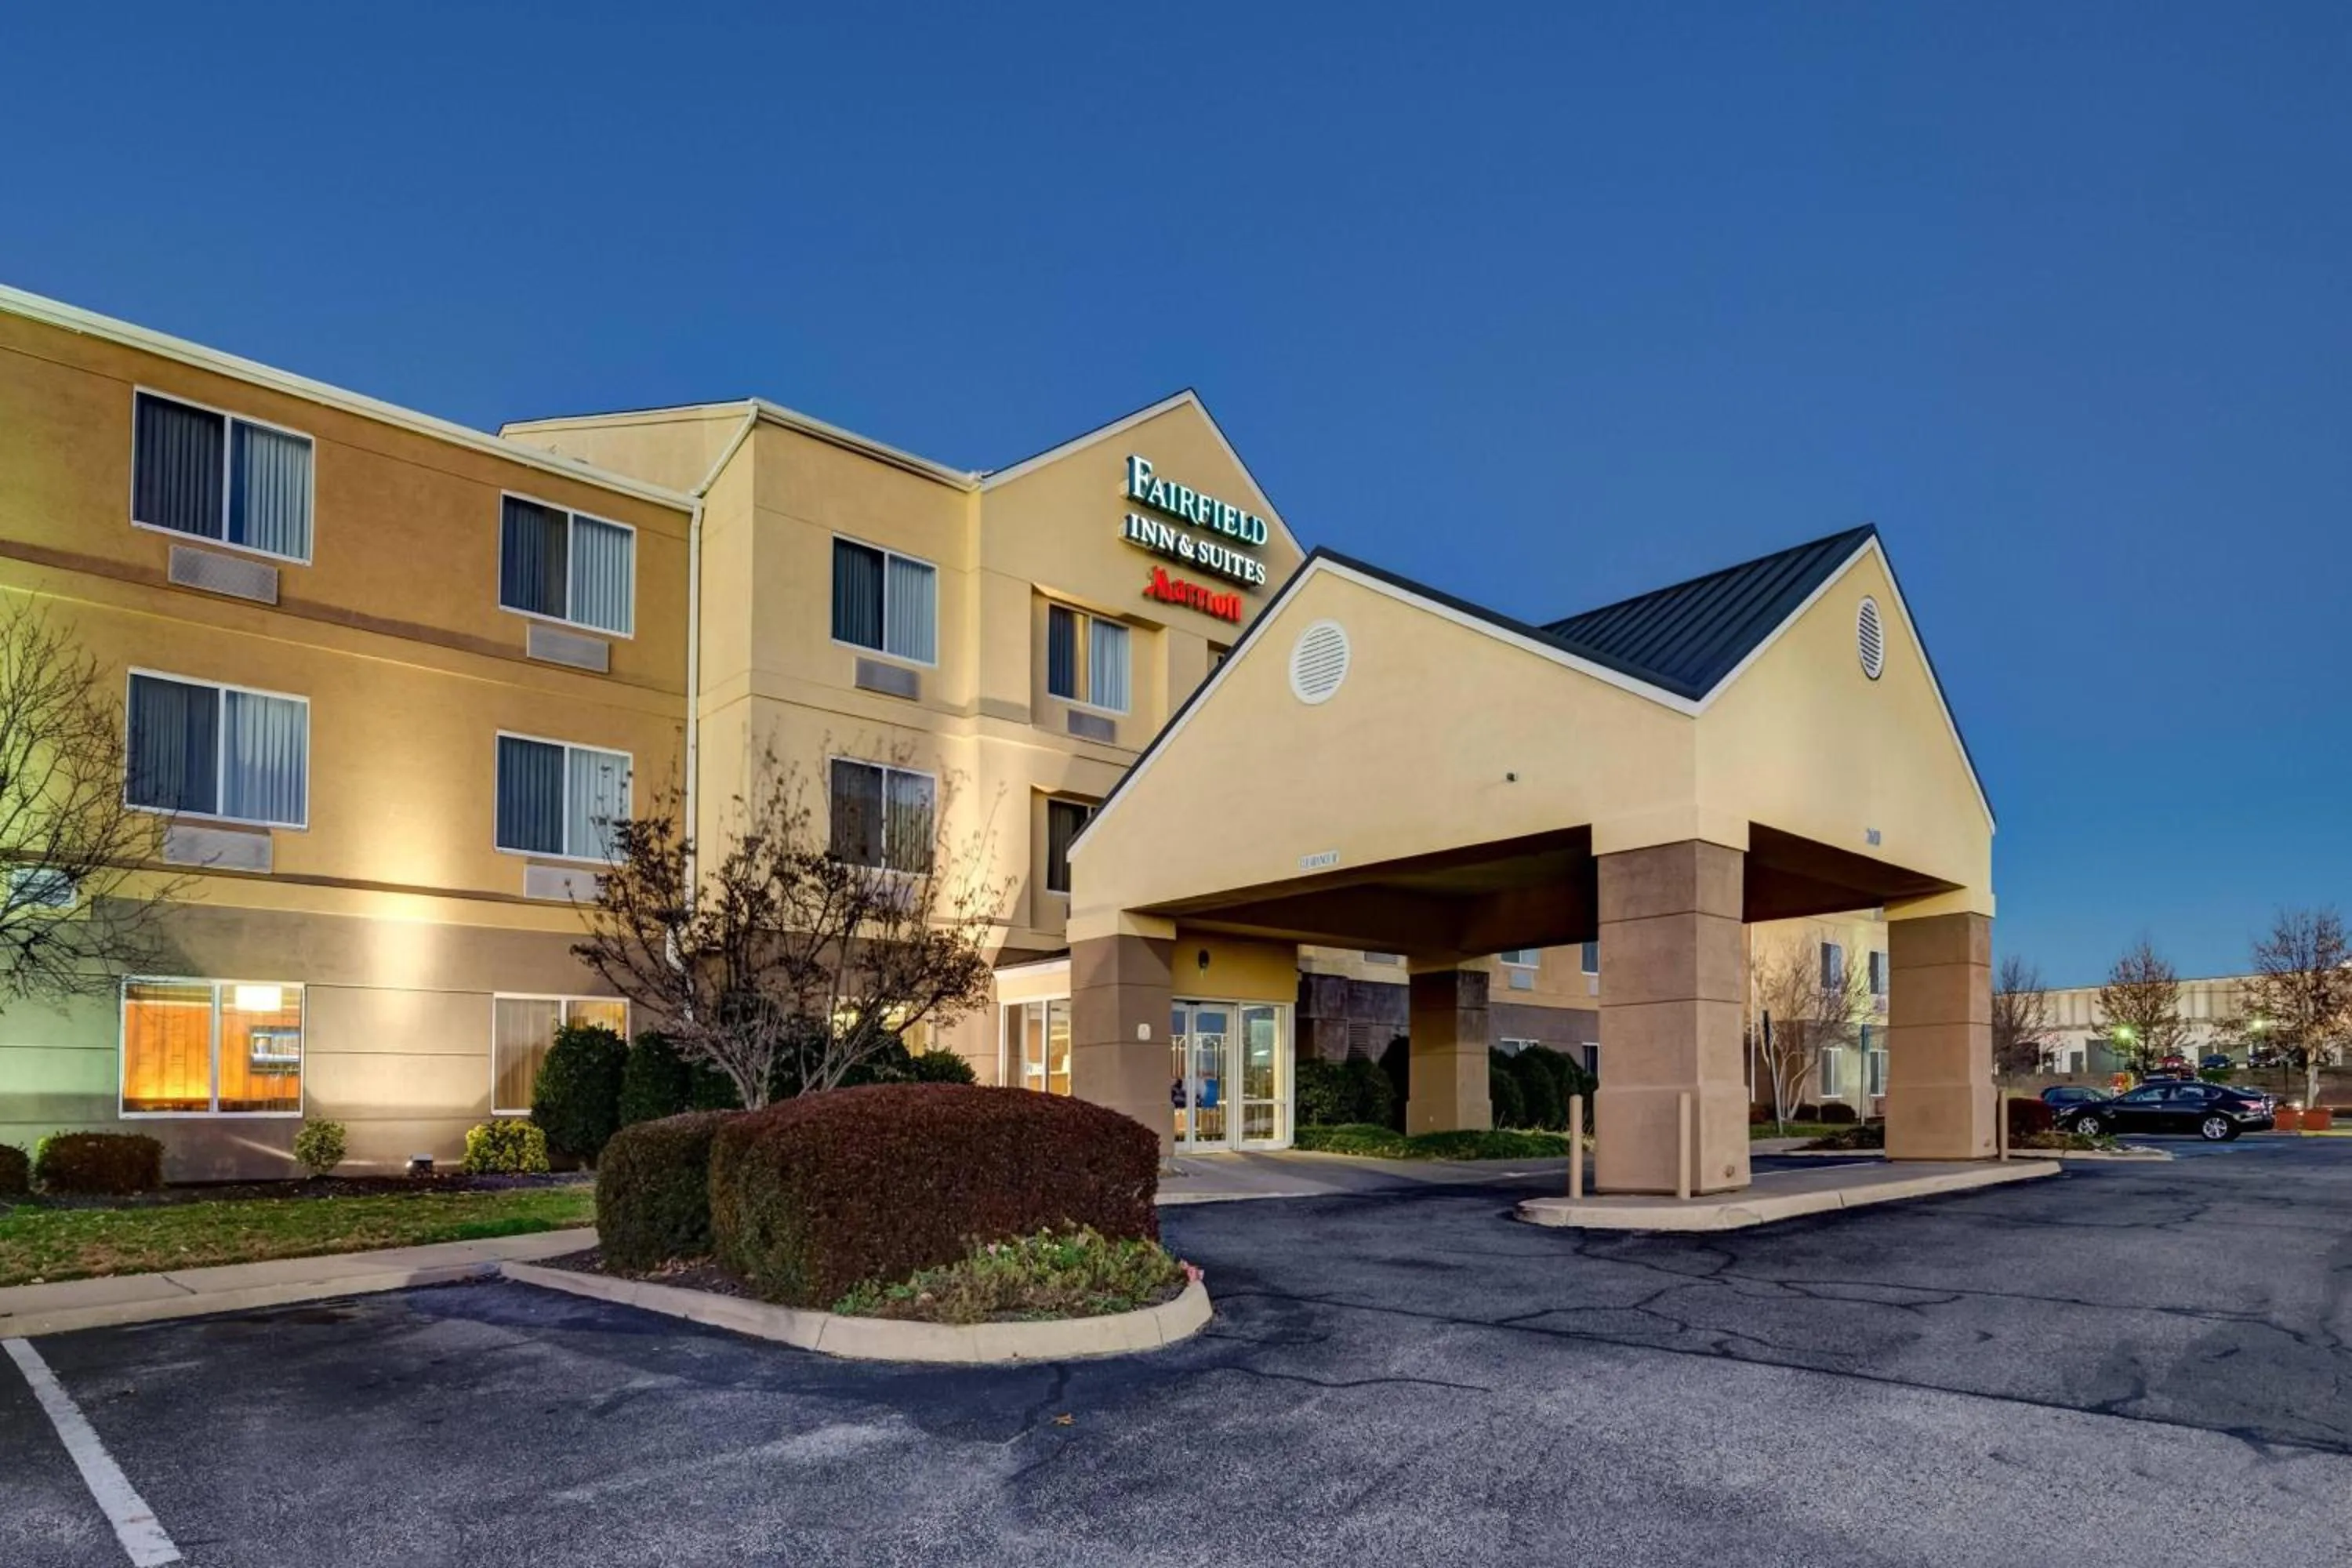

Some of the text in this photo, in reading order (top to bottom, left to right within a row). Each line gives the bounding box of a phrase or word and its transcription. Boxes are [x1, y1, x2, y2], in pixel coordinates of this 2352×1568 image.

[1130, 455, 1269, 546] FAIRFIELD
[1128, 514, 1266, 586] INN & SUITES
[1142, 564, 1242, 623] Marriott
